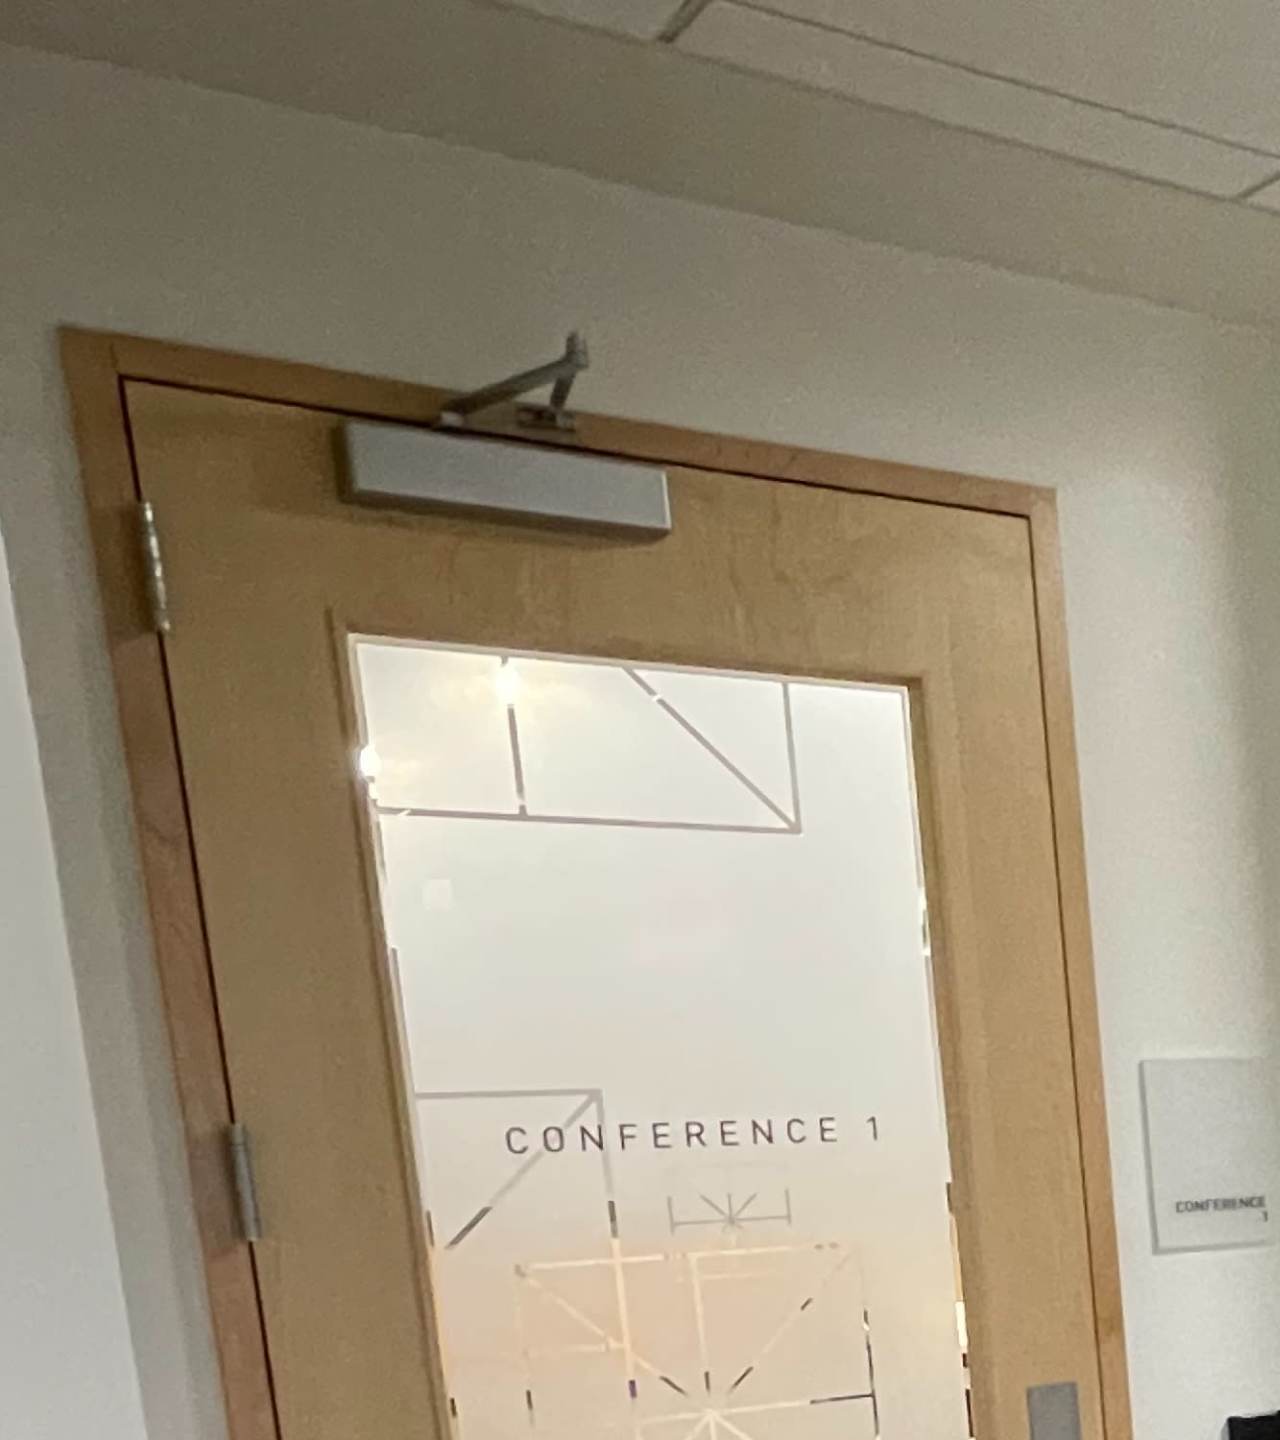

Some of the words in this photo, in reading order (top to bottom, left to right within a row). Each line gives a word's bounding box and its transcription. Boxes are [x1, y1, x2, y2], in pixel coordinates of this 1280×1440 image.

[505, 1117, 839, 1154] CONFERENCE
[866, 1116, 879, 1141] 1
[1176, 1196, 1265, 1213] CONFERENCE
